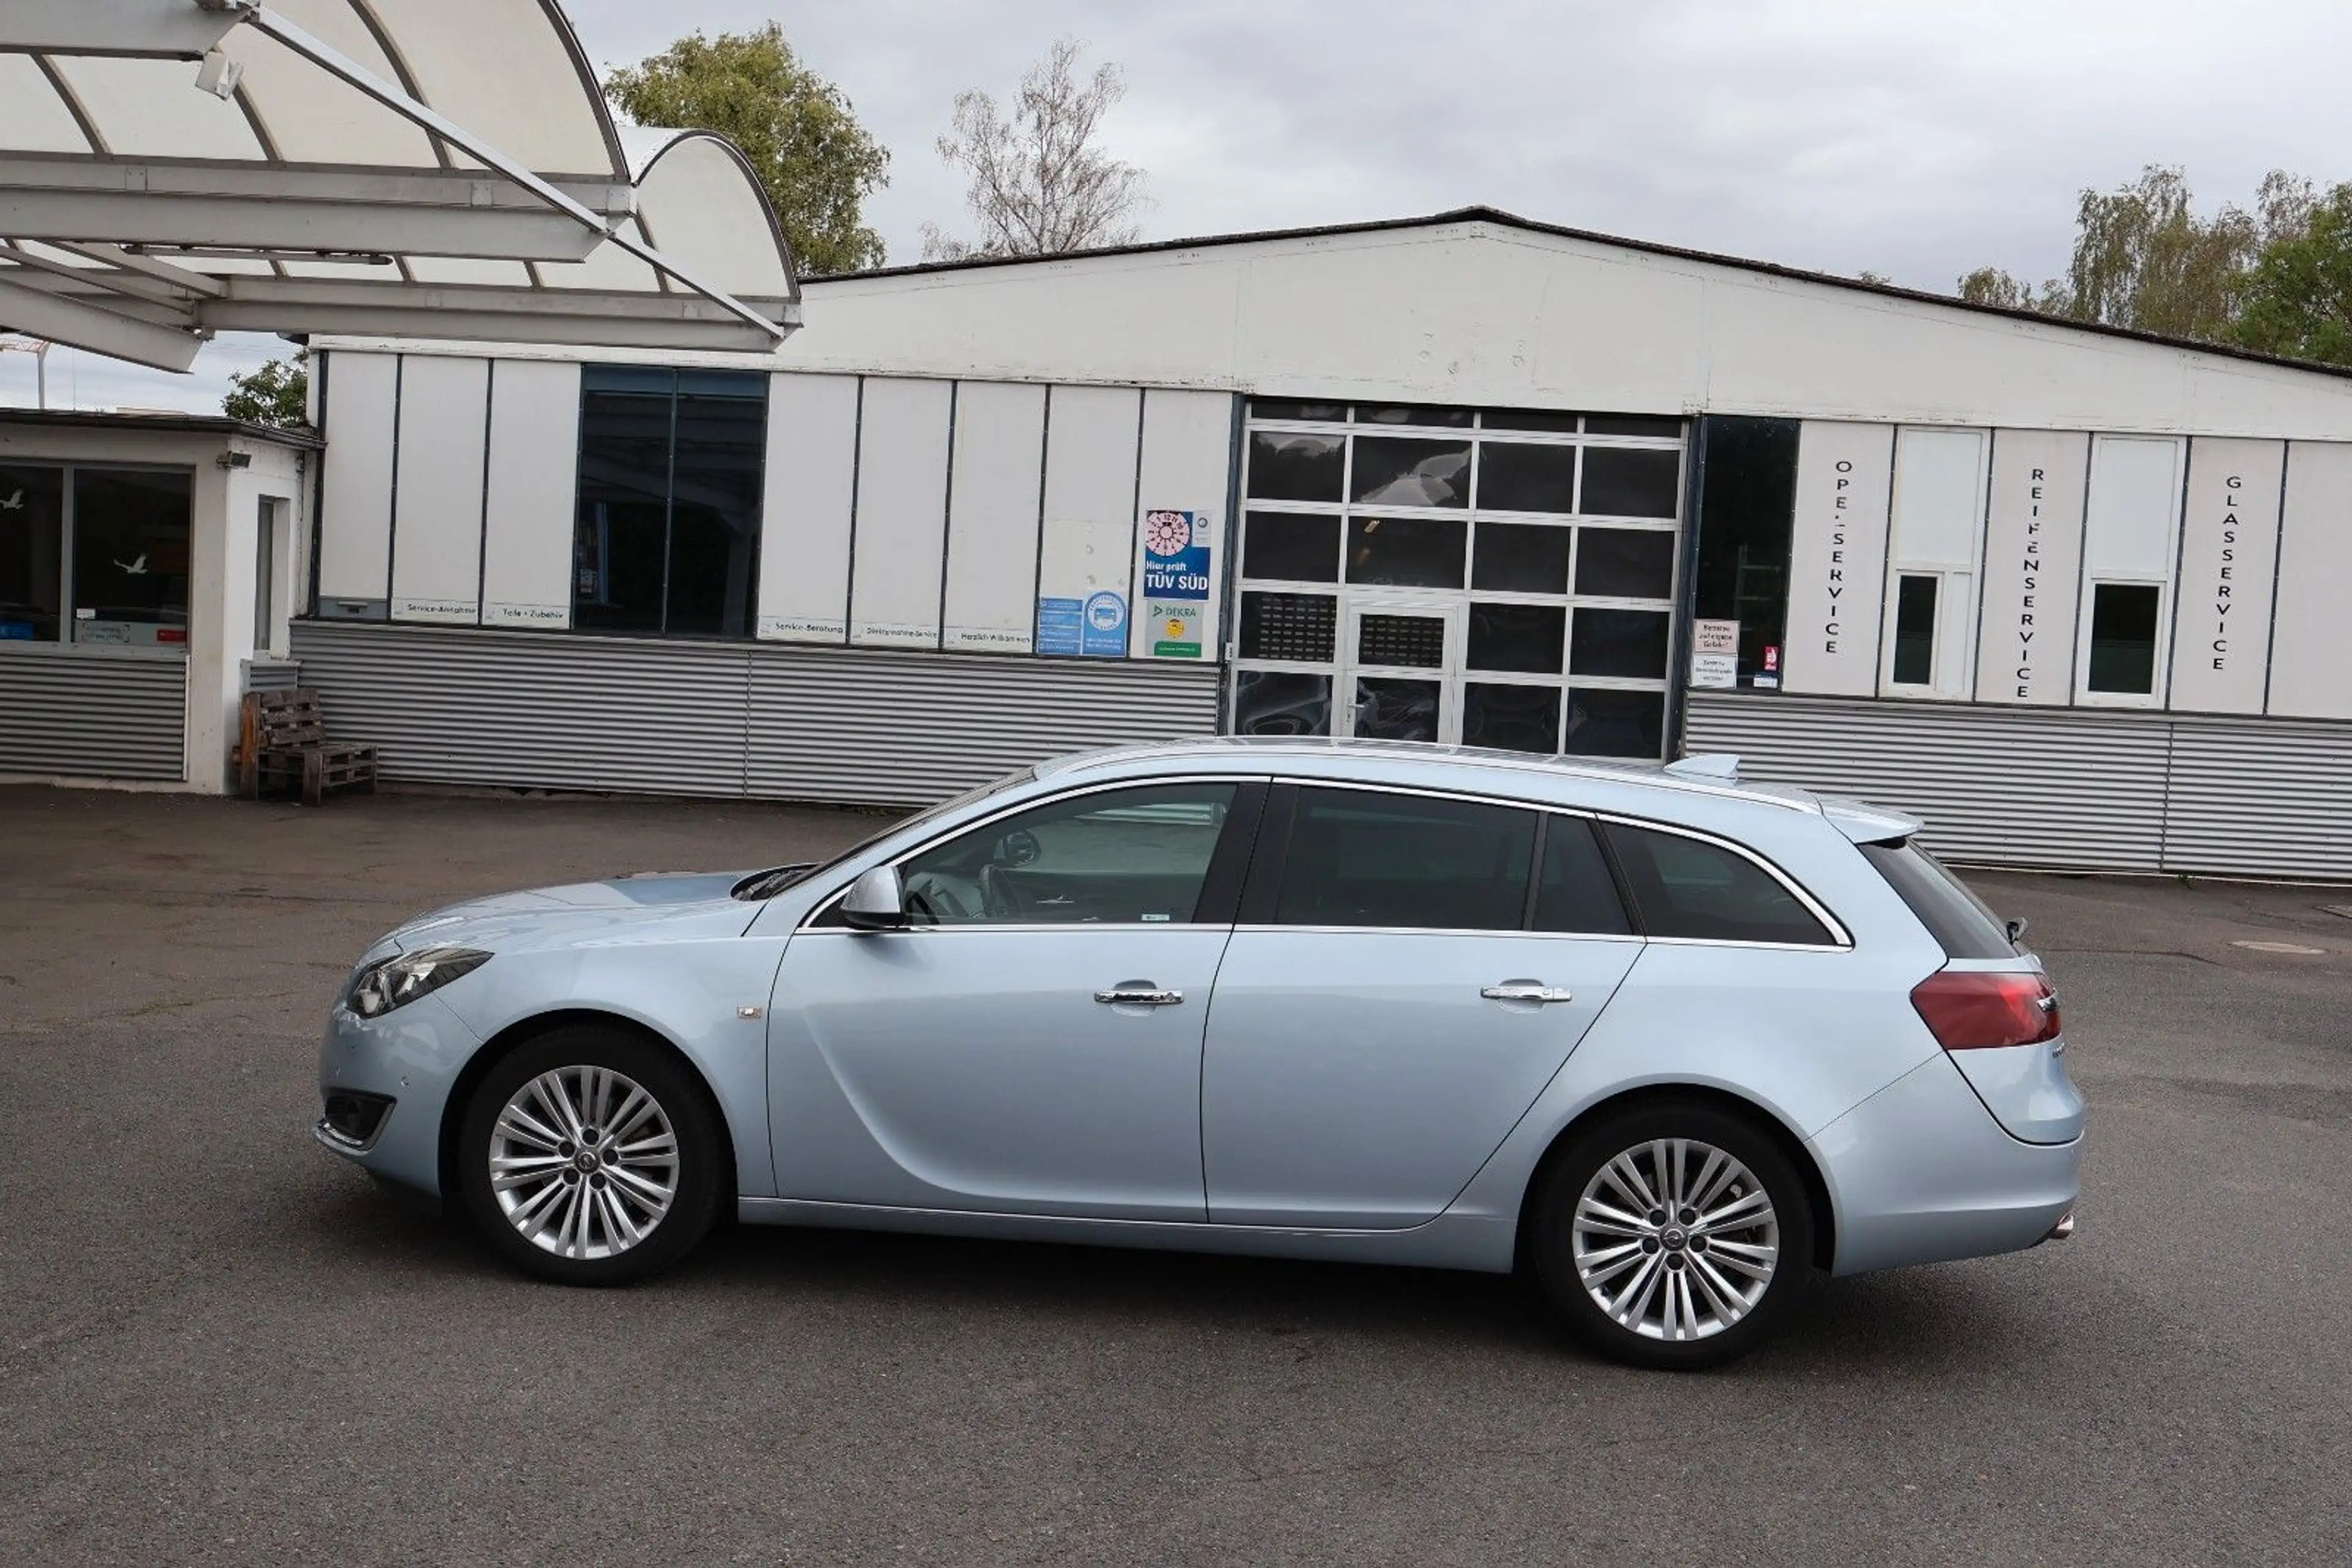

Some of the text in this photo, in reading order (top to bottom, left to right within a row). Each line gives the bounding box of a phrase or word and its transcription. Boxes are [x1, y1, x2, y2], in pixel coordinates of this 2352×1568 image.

[1146, 560, 1164, 570] Hier
[2213, 476, 2241, 670] GLASSERVICE
[1147, 571, 1208, 590] TÜV SÜD
[2017, 469, 2045, 697] REIFENSERVICE
[1166, 607, 1196, 617] DEKRA
